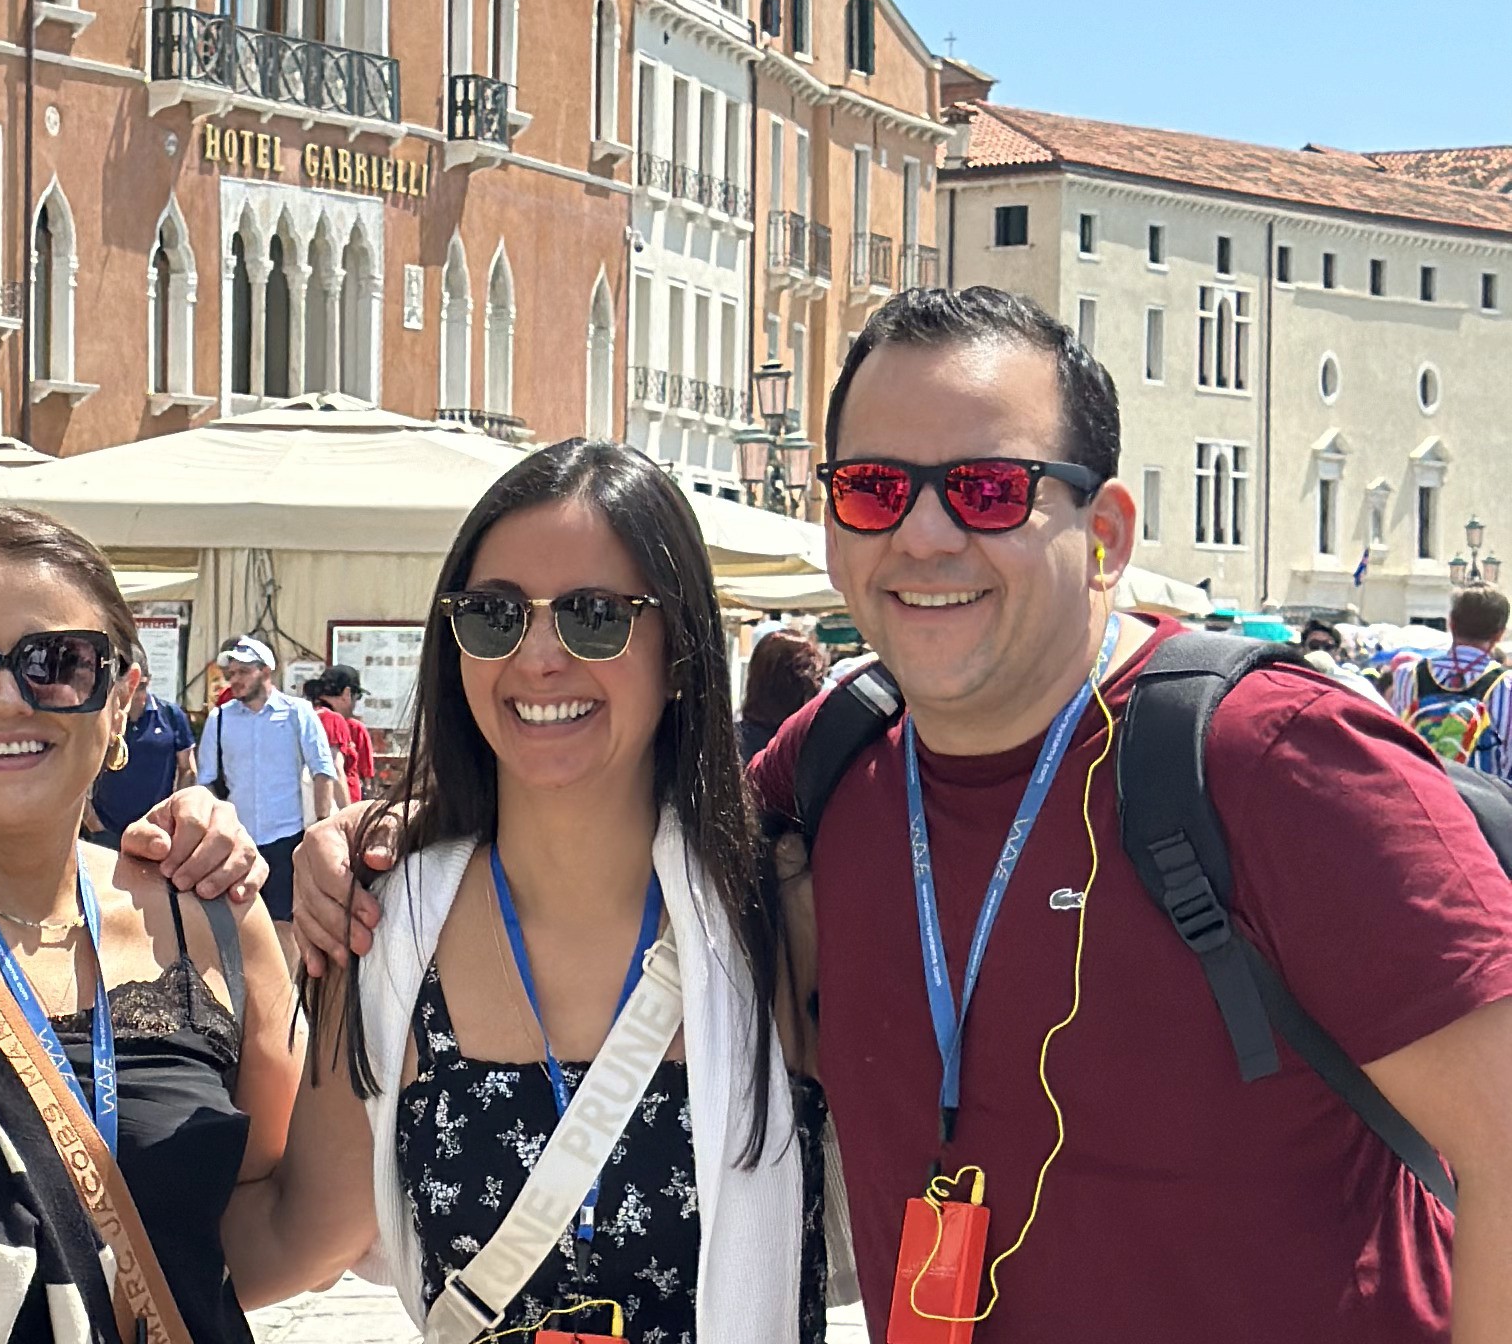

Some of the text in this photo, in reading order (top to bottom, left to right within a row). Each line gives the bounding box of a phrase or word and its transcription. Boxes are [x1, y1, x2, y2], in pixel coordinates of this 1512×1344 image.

[205, 123, 430, 197] HOTEL GABRIELLI
[96, 1058, 115, 1116] WAVE
[556, 992, 676, 1166] PRUNE
[42, 1102, 122, 1237] JACOBS
[481, 1185, 571, 1288] UNE
